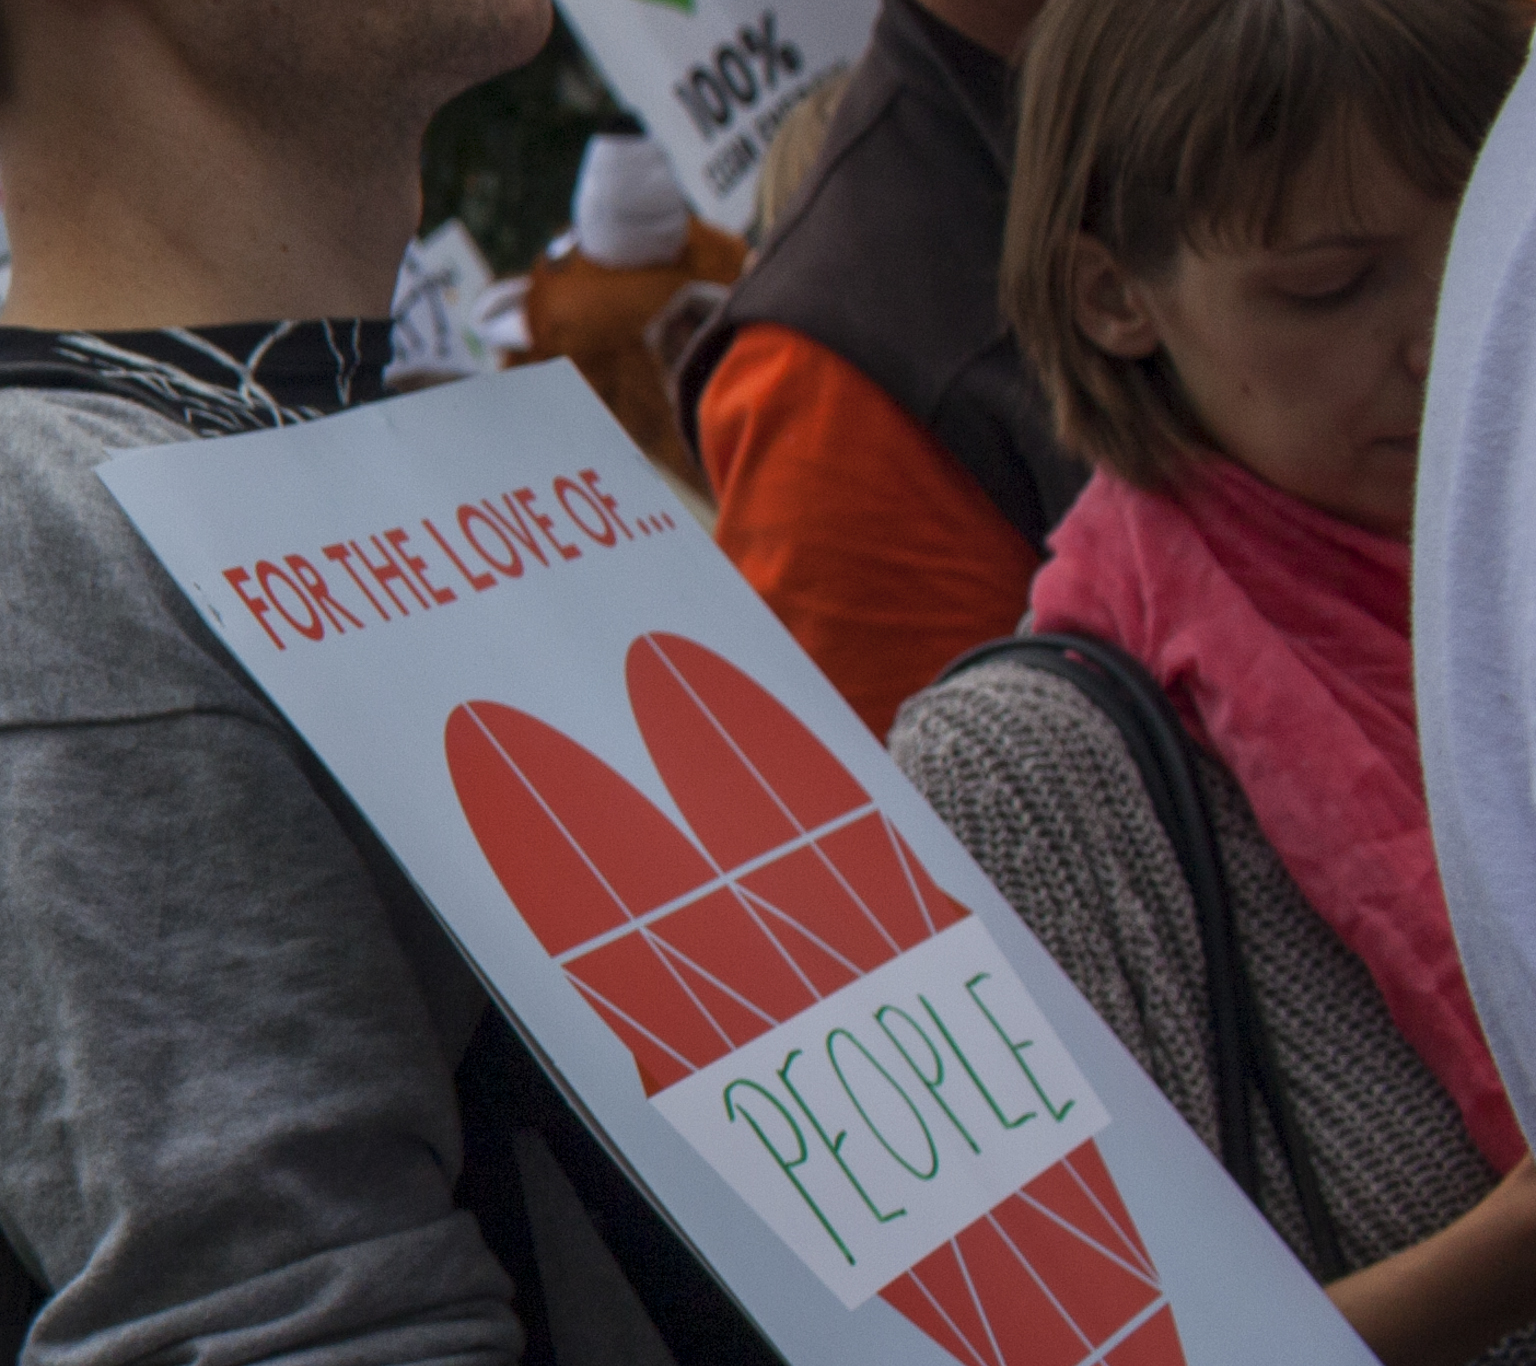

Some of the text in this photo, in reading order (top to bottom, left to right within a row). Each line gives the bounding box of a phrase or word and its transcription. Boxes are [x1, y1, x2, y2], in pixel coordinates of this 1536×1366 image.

[673, 8, 804, 141] 100%
[222, 553, 364, 651] FOR
[322, 527, 458, 621] THE
[421, 486, 583, 593] LOVE
[723, 971, 1075, 1266] PEOPLE
